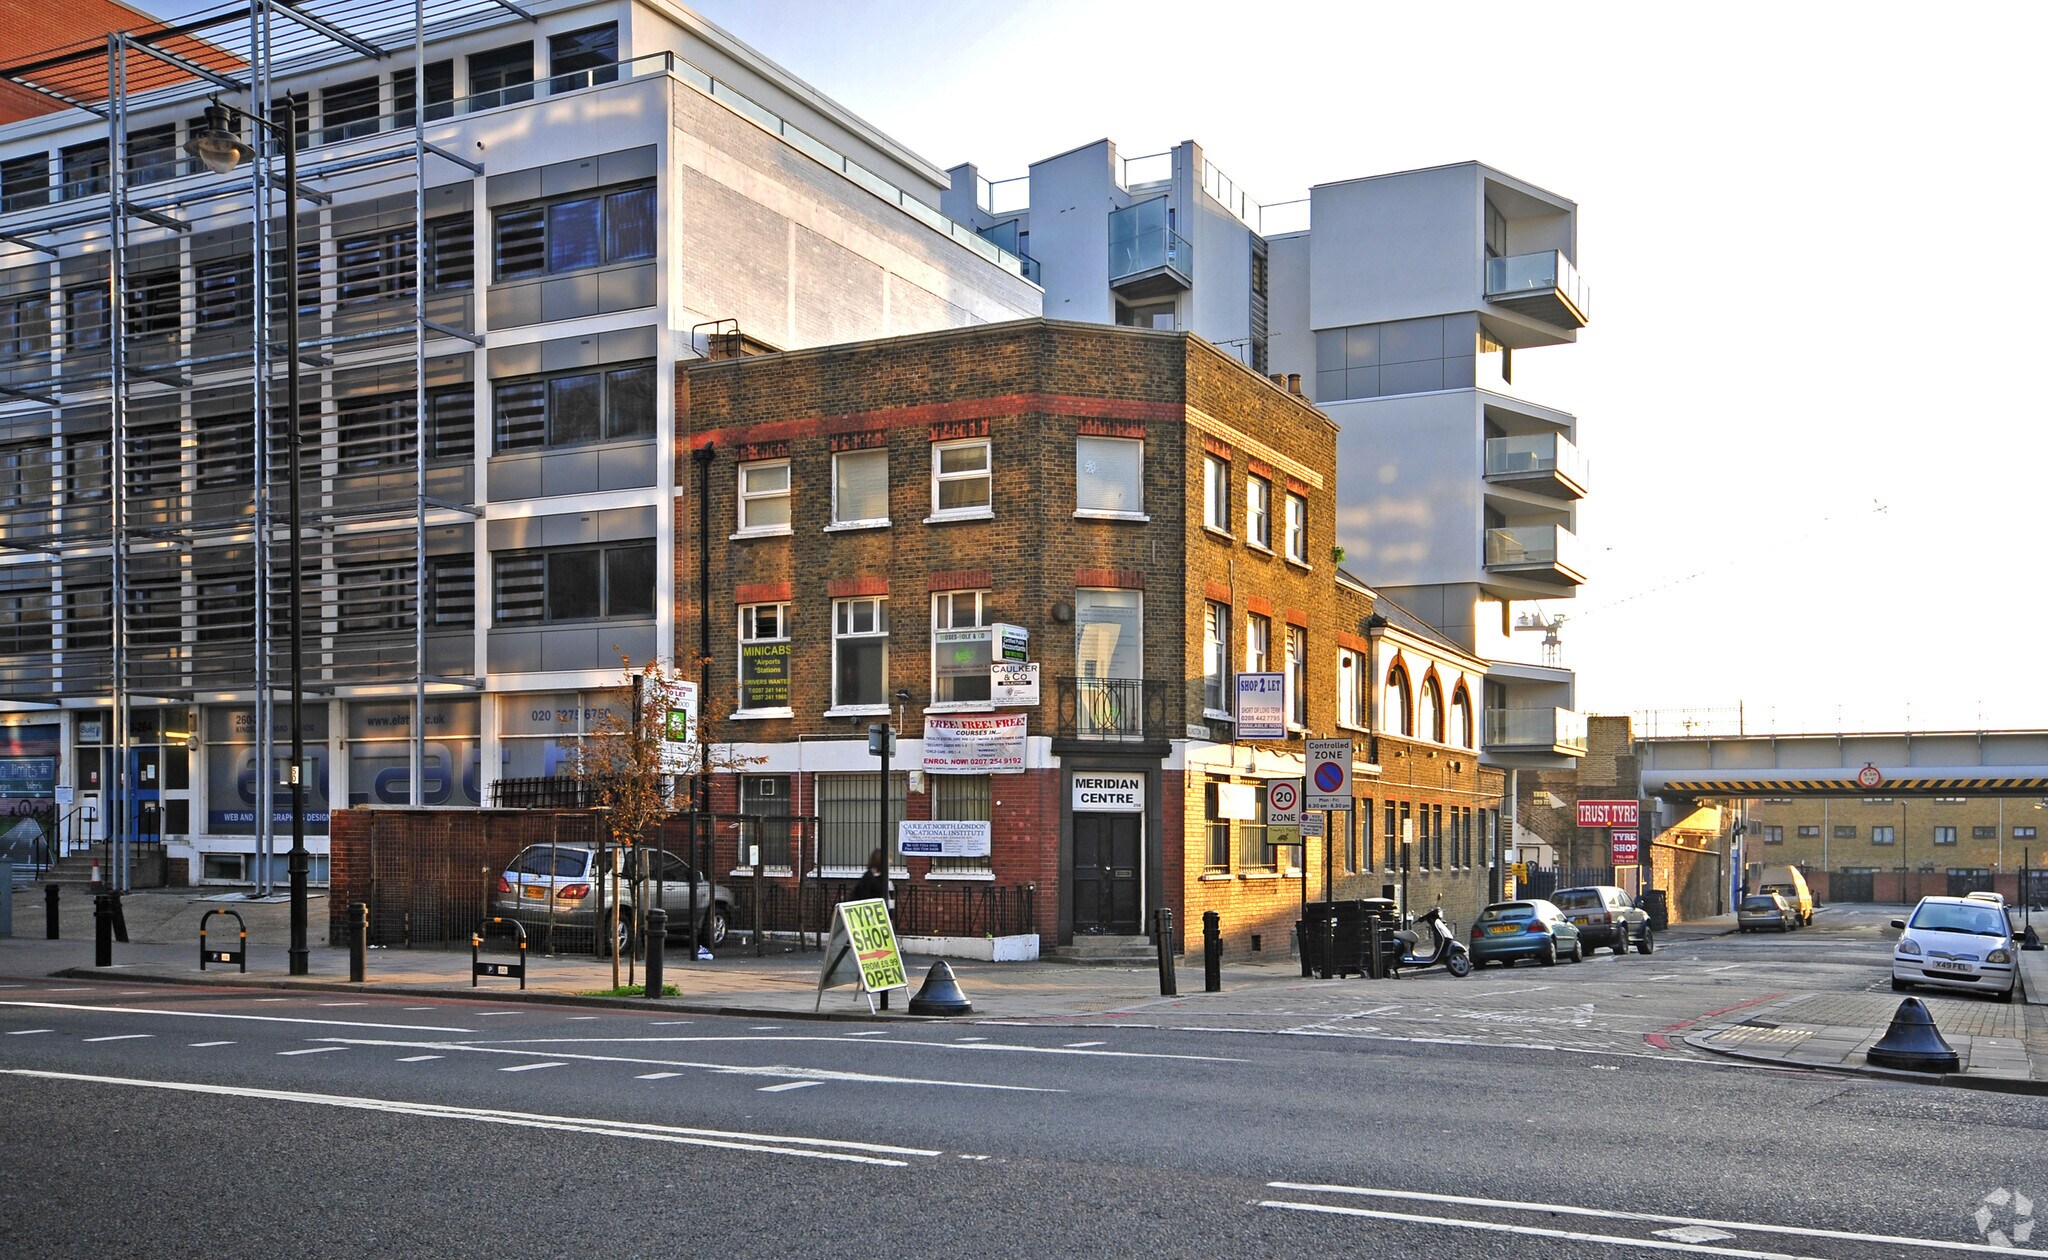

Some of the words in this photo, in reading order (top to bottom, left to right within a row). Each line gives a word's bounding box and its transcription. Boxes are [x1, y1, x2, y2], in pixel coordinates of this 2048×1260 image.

[744, 645, 792, 656] MINICABS
[992, 665, 1037, 673] CAULKER
[1241, 680, 1258, 692] SHOP
[1259, 678, 1265, 693] 2
[1267, 680, 1280, 692] LET
[531, 711, 552, 721] 020
[930, 719, 959, 729] FREE!
[961, 720, 993, 729] FREE!
[995, 717, 1026, 728] FREE!
[1314, 751, 1343, 759] ZONE
[923, 757, 948, 765] ENROL
[1075, 778, 1139, 789] MERIDIAN
[1080, 793, 1134, 804] CENTRE
[1275, 792, 1292, 802] 20
[223, 813, 239, 822] WEB
[240, 813, 254, 822] AND
[1579, 805, 1610, 822] TRUST
[1612, 805, 1637, 822] TYRE
[1613, 833, 1637, 841] TYRE
[1613, 844, 1638, 852] SHOP
[844, 904, 886, 929] TYRE
[852, 926, 890, 951] SHOP
[862, 961, 880, 971] FROM
[881, 958, 899, 968] £9.99
[865, 966, 904, 988] OPEN
